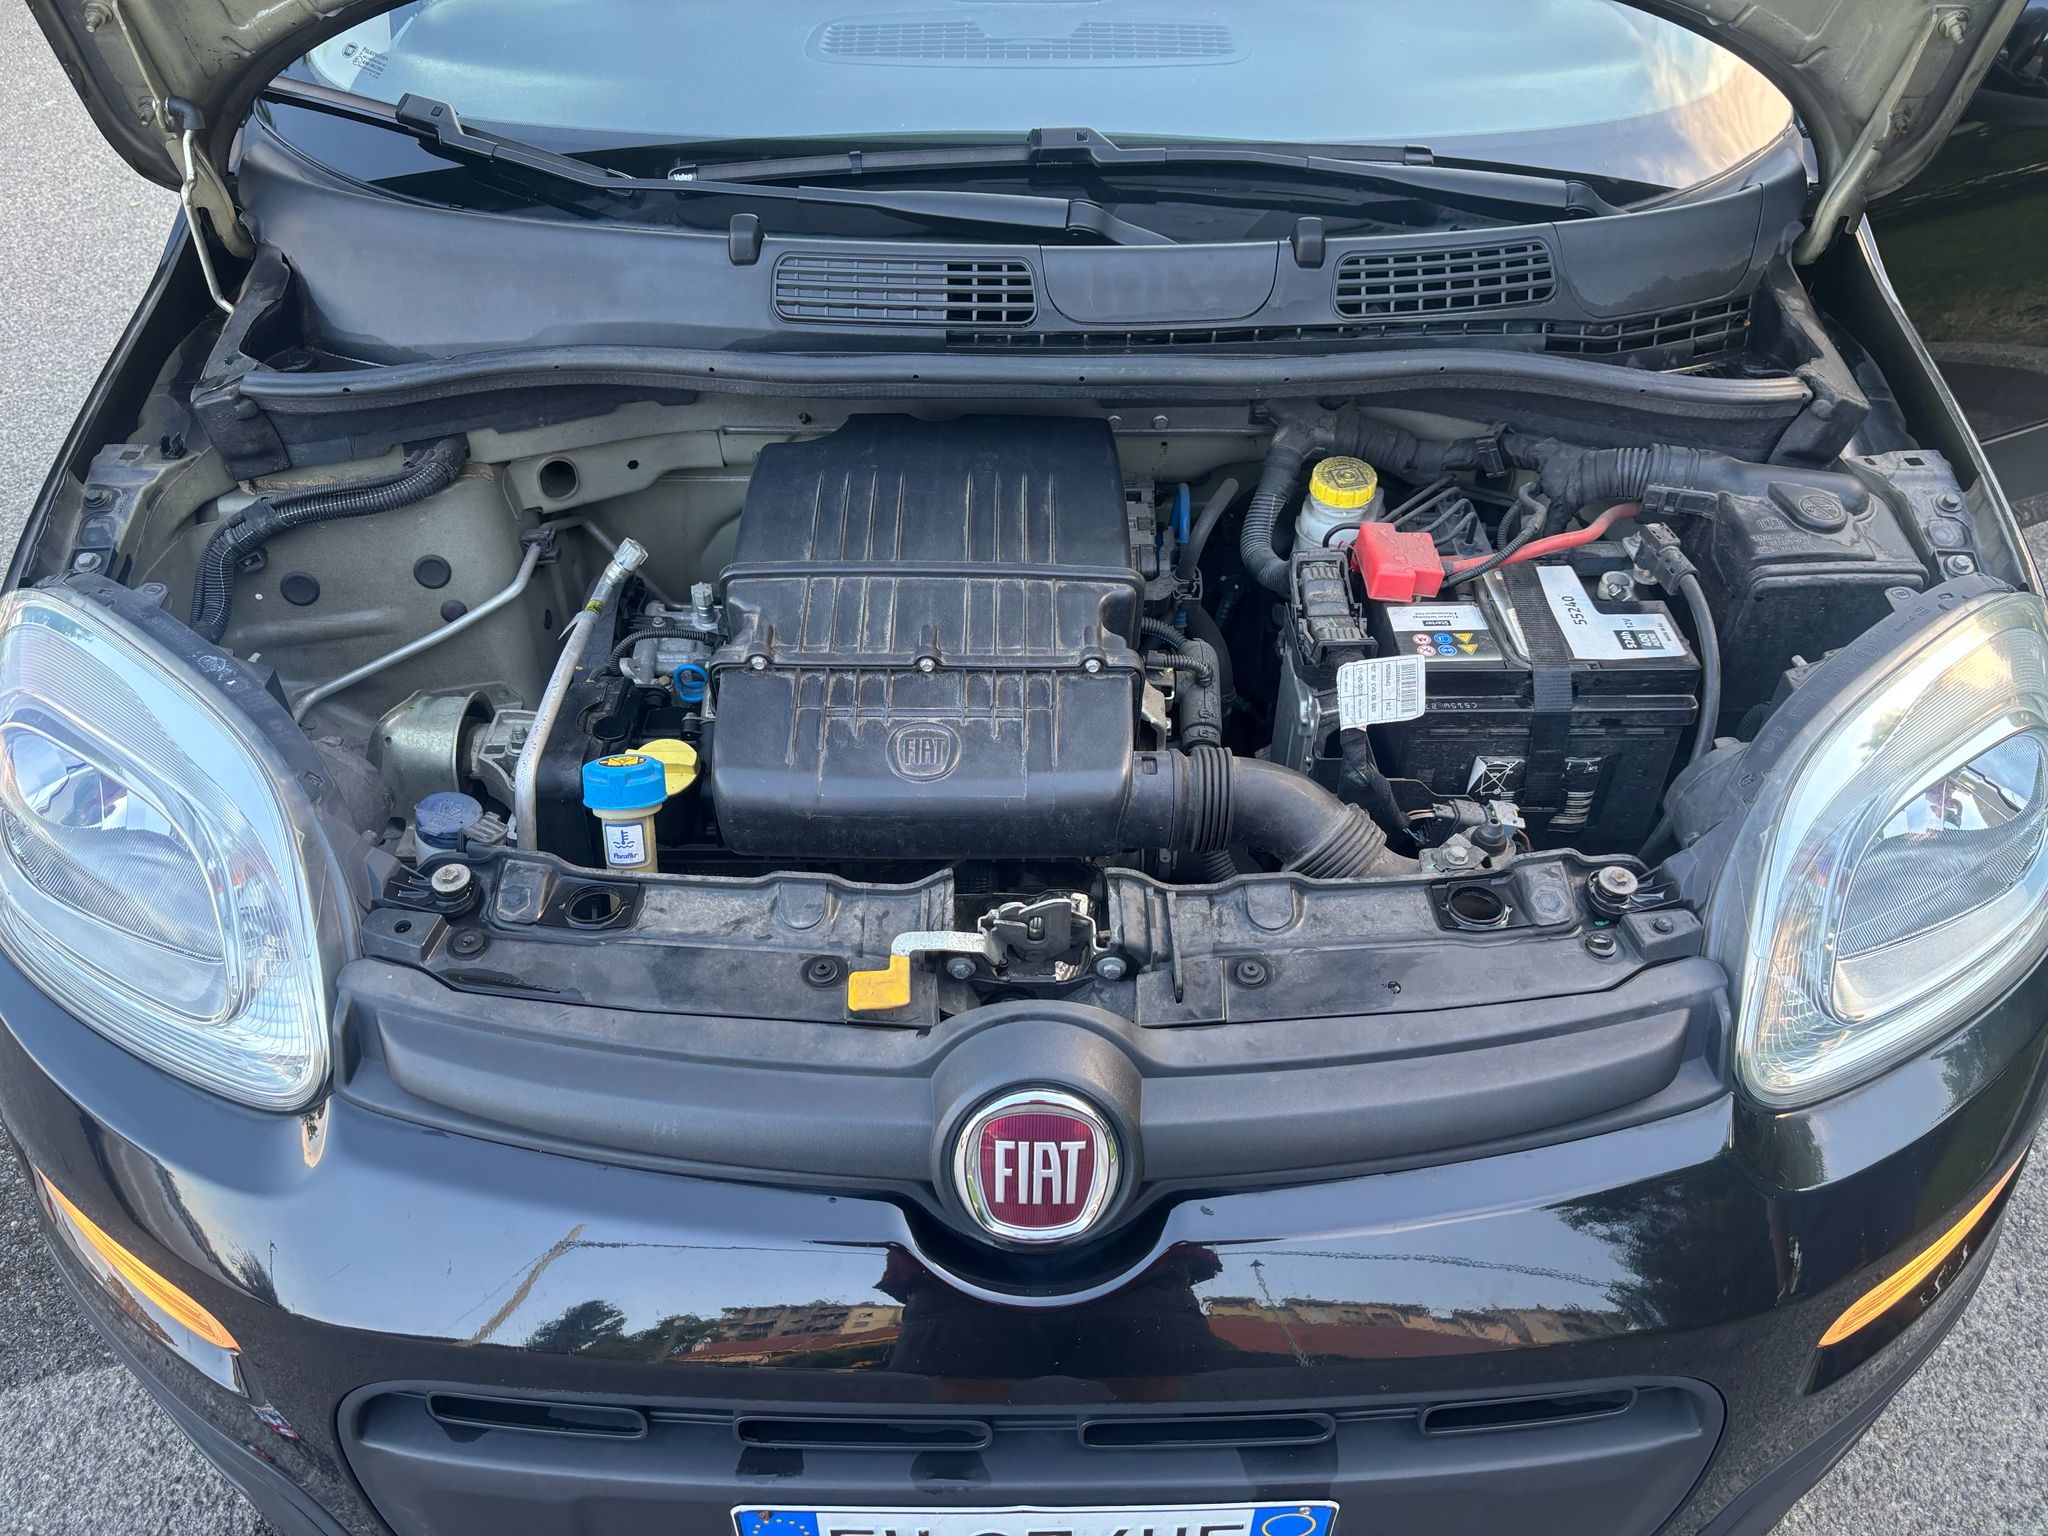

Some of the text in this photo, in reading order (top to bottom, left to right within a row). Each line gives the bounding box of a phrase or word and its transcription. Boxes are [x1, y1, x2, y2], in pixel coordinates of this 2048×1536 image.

[674, 173, 693, 181] Valeo
[1561, 595, 1588, 625] 55240
[1619, 617, 1638, 648] 52Ah 12V
[903, 738, 946, 765] FIAT
[994, 1140, 1087, 1205] FIAT
